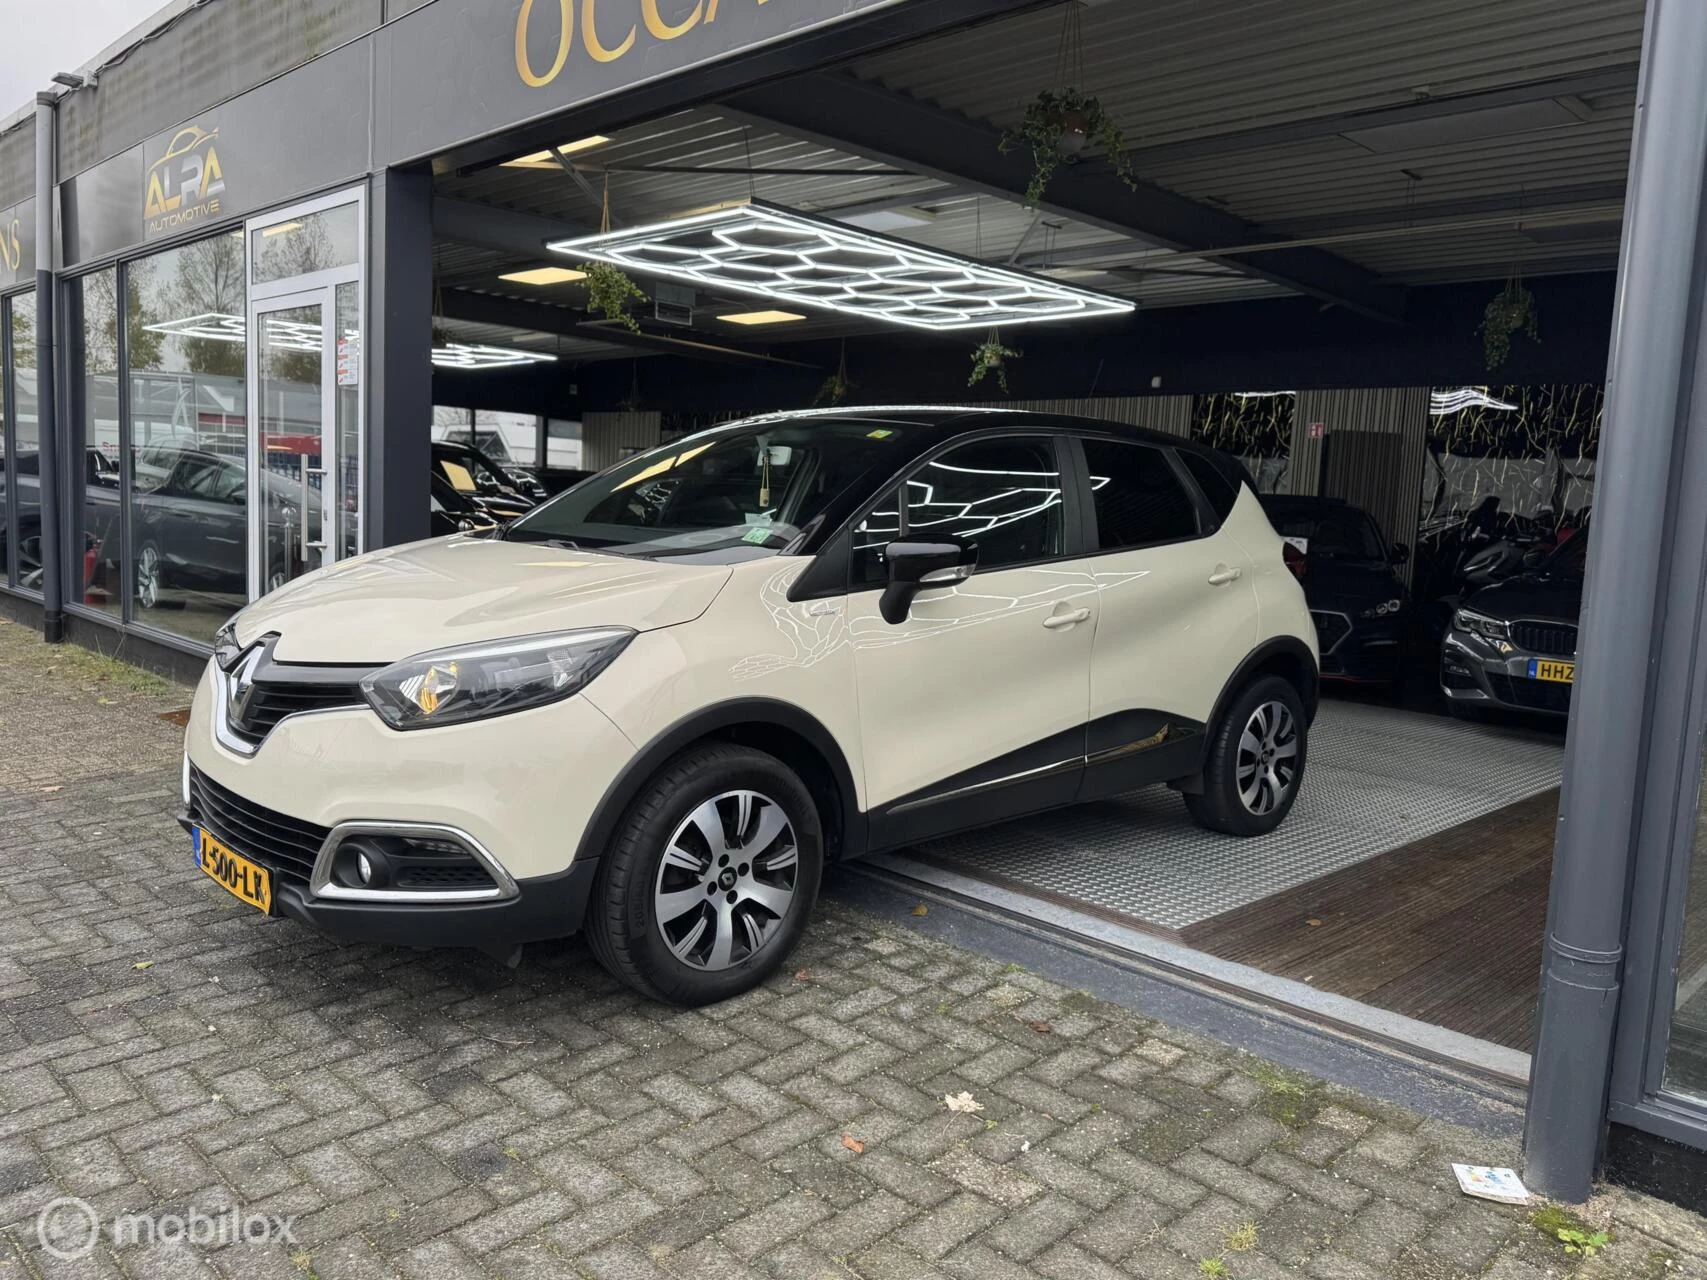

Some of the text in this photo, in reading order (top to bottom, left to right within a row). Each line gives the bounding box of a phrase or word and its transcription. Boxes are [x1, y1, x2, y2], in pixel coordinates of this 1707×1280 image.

[144, 146, 225, 219] ALRA
[149, 199, 220, 233] AUTOMOTIVE
[203, 839, 265, 905] L-500-LK
